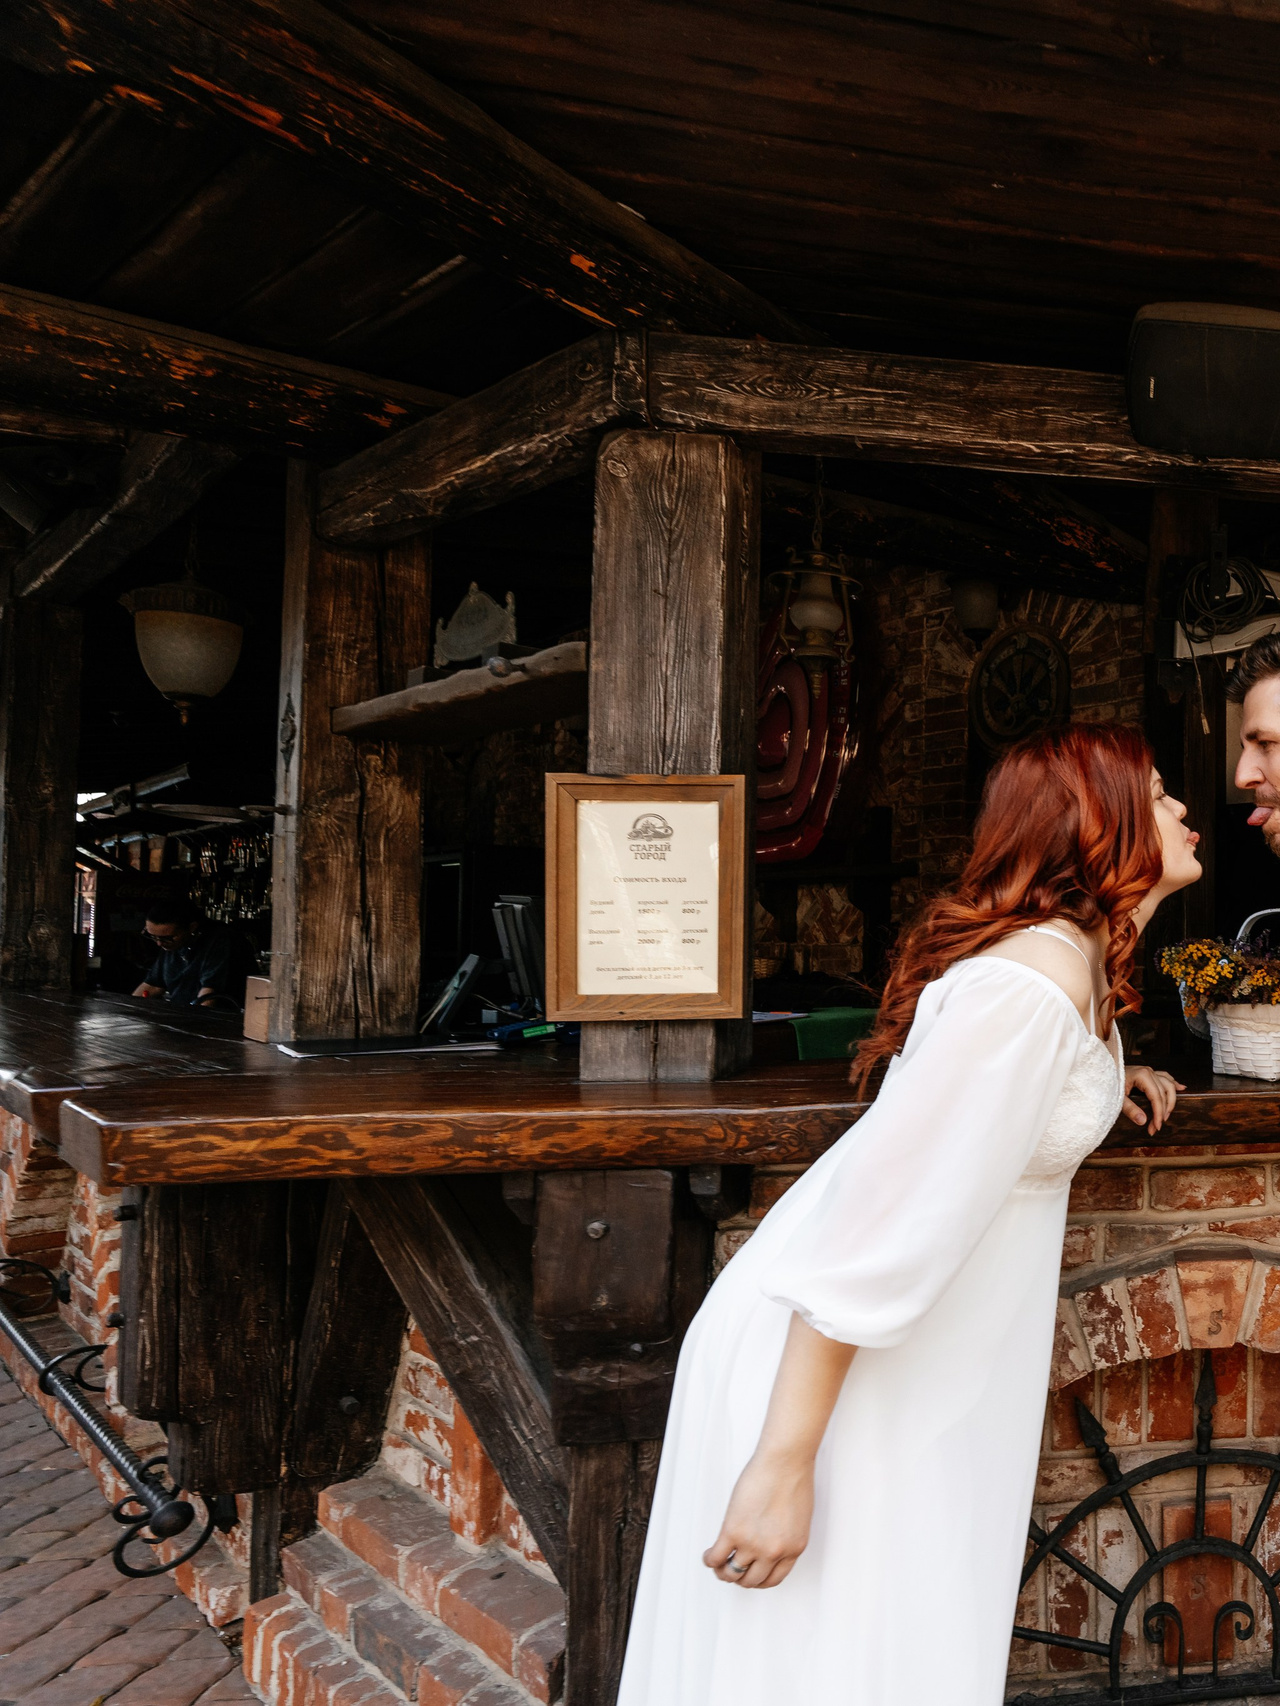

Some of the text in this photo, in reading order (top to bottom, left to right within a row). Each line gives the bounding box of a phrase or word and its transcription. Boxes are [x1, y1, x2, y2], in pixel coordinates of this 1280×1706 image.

[629, 842, 671, 852] СТАРЫЙ
[634, 852, 666, 861] ГОРОД
[1207, 1309, 1223, 1336] S
